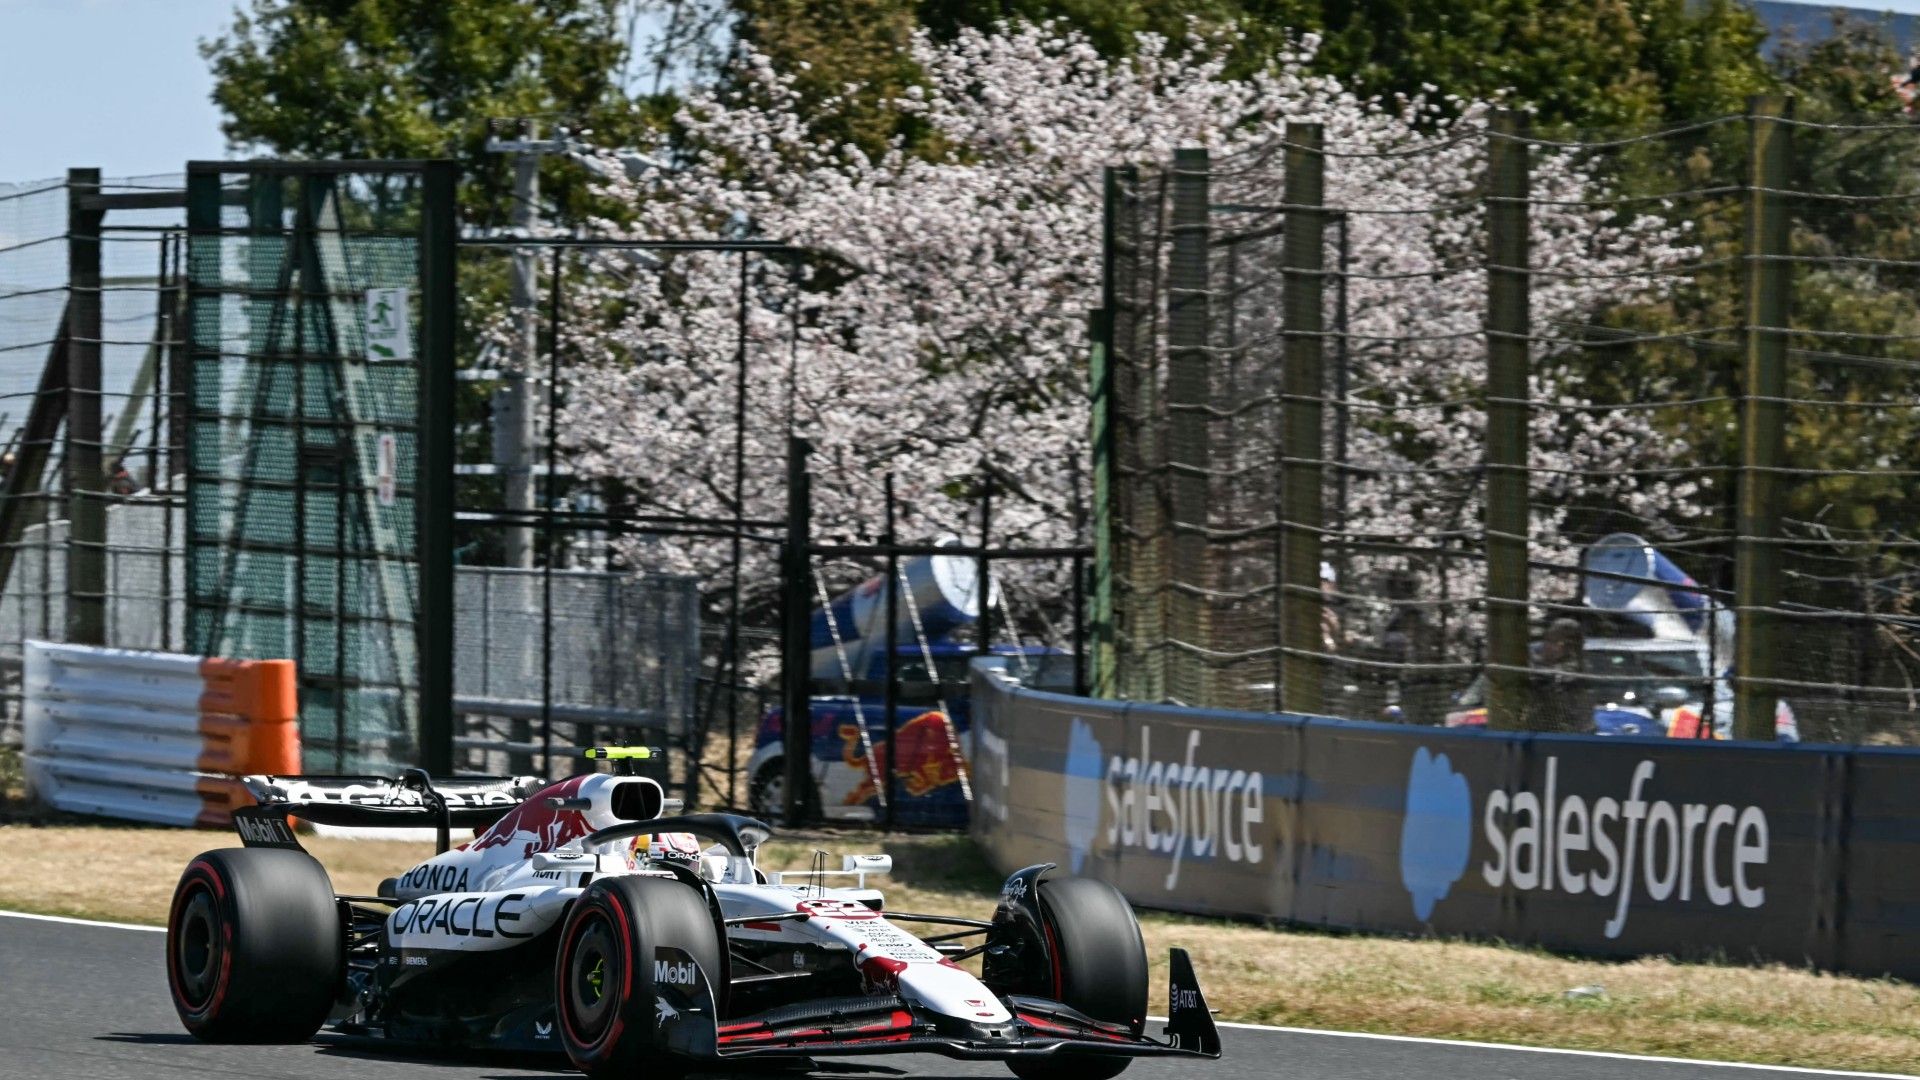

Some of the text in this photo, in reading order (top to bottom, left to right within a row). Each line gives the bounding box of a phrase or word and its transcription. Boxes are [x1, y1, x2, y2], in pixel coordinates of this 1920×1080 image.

[1106, 725, 1263, 890] salesforce
[235, 816, 280, 842] Mobil
[1482, 756, 1769, 939] salesforce
[401, 864, 469, 892] HONDA
[393, 894, 534, 938] ORACLE
[654, 960, 696, 985] Mobil
[1179, 989, 1197, 1009] AT&T
